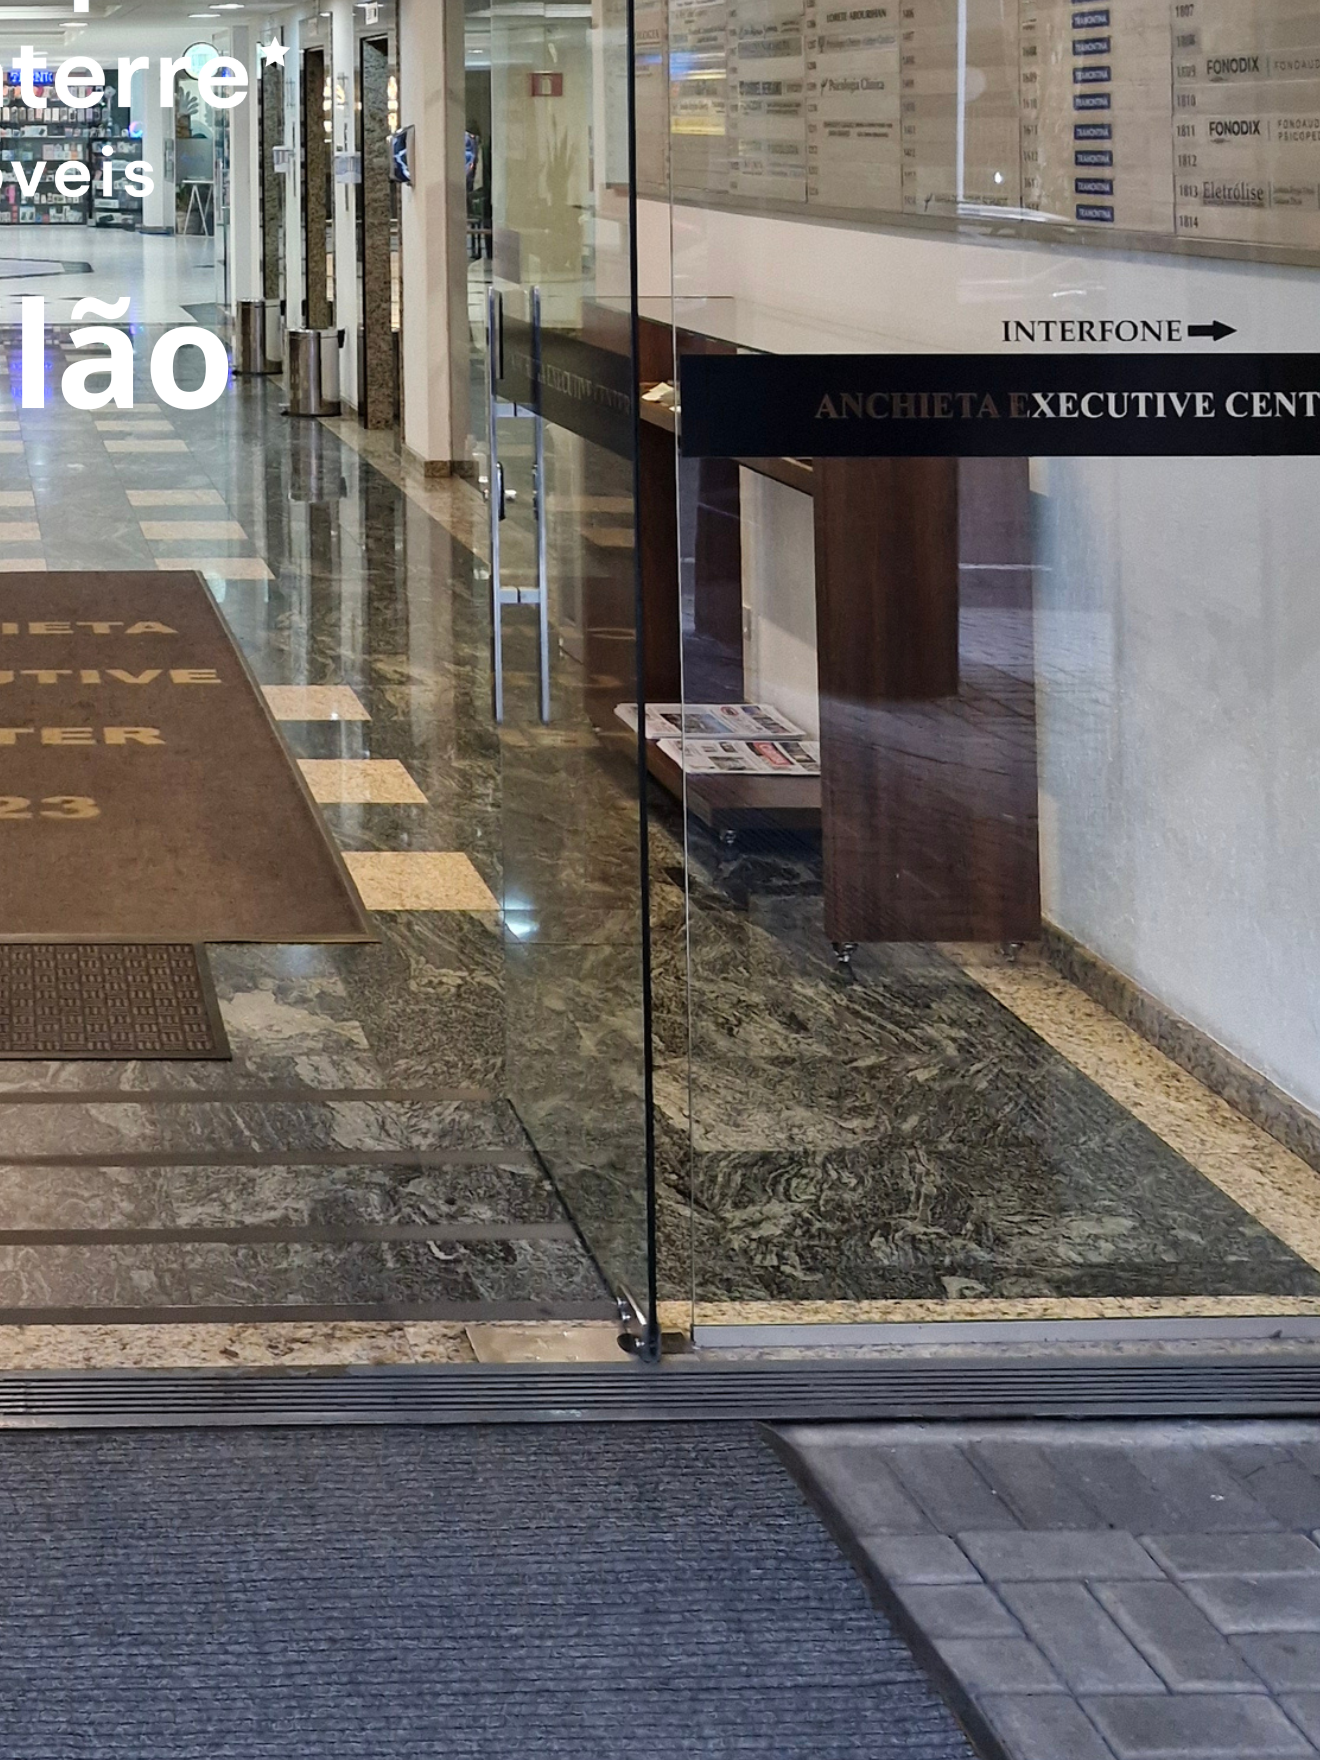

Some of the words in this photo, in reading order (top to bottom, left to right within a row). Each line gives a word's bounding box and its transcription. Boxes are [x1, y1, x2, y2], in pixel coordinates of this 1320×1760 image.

[1206, 56, 1260, 76] FONODIX
[1208, 120, 1261, 137] FONODIX
[1002, 320, 1182, 342] INTERFONE
[814, 393, 1000, 419] ANCHIETA
[1008, 391, 1215, 418] EXECUTIVE
